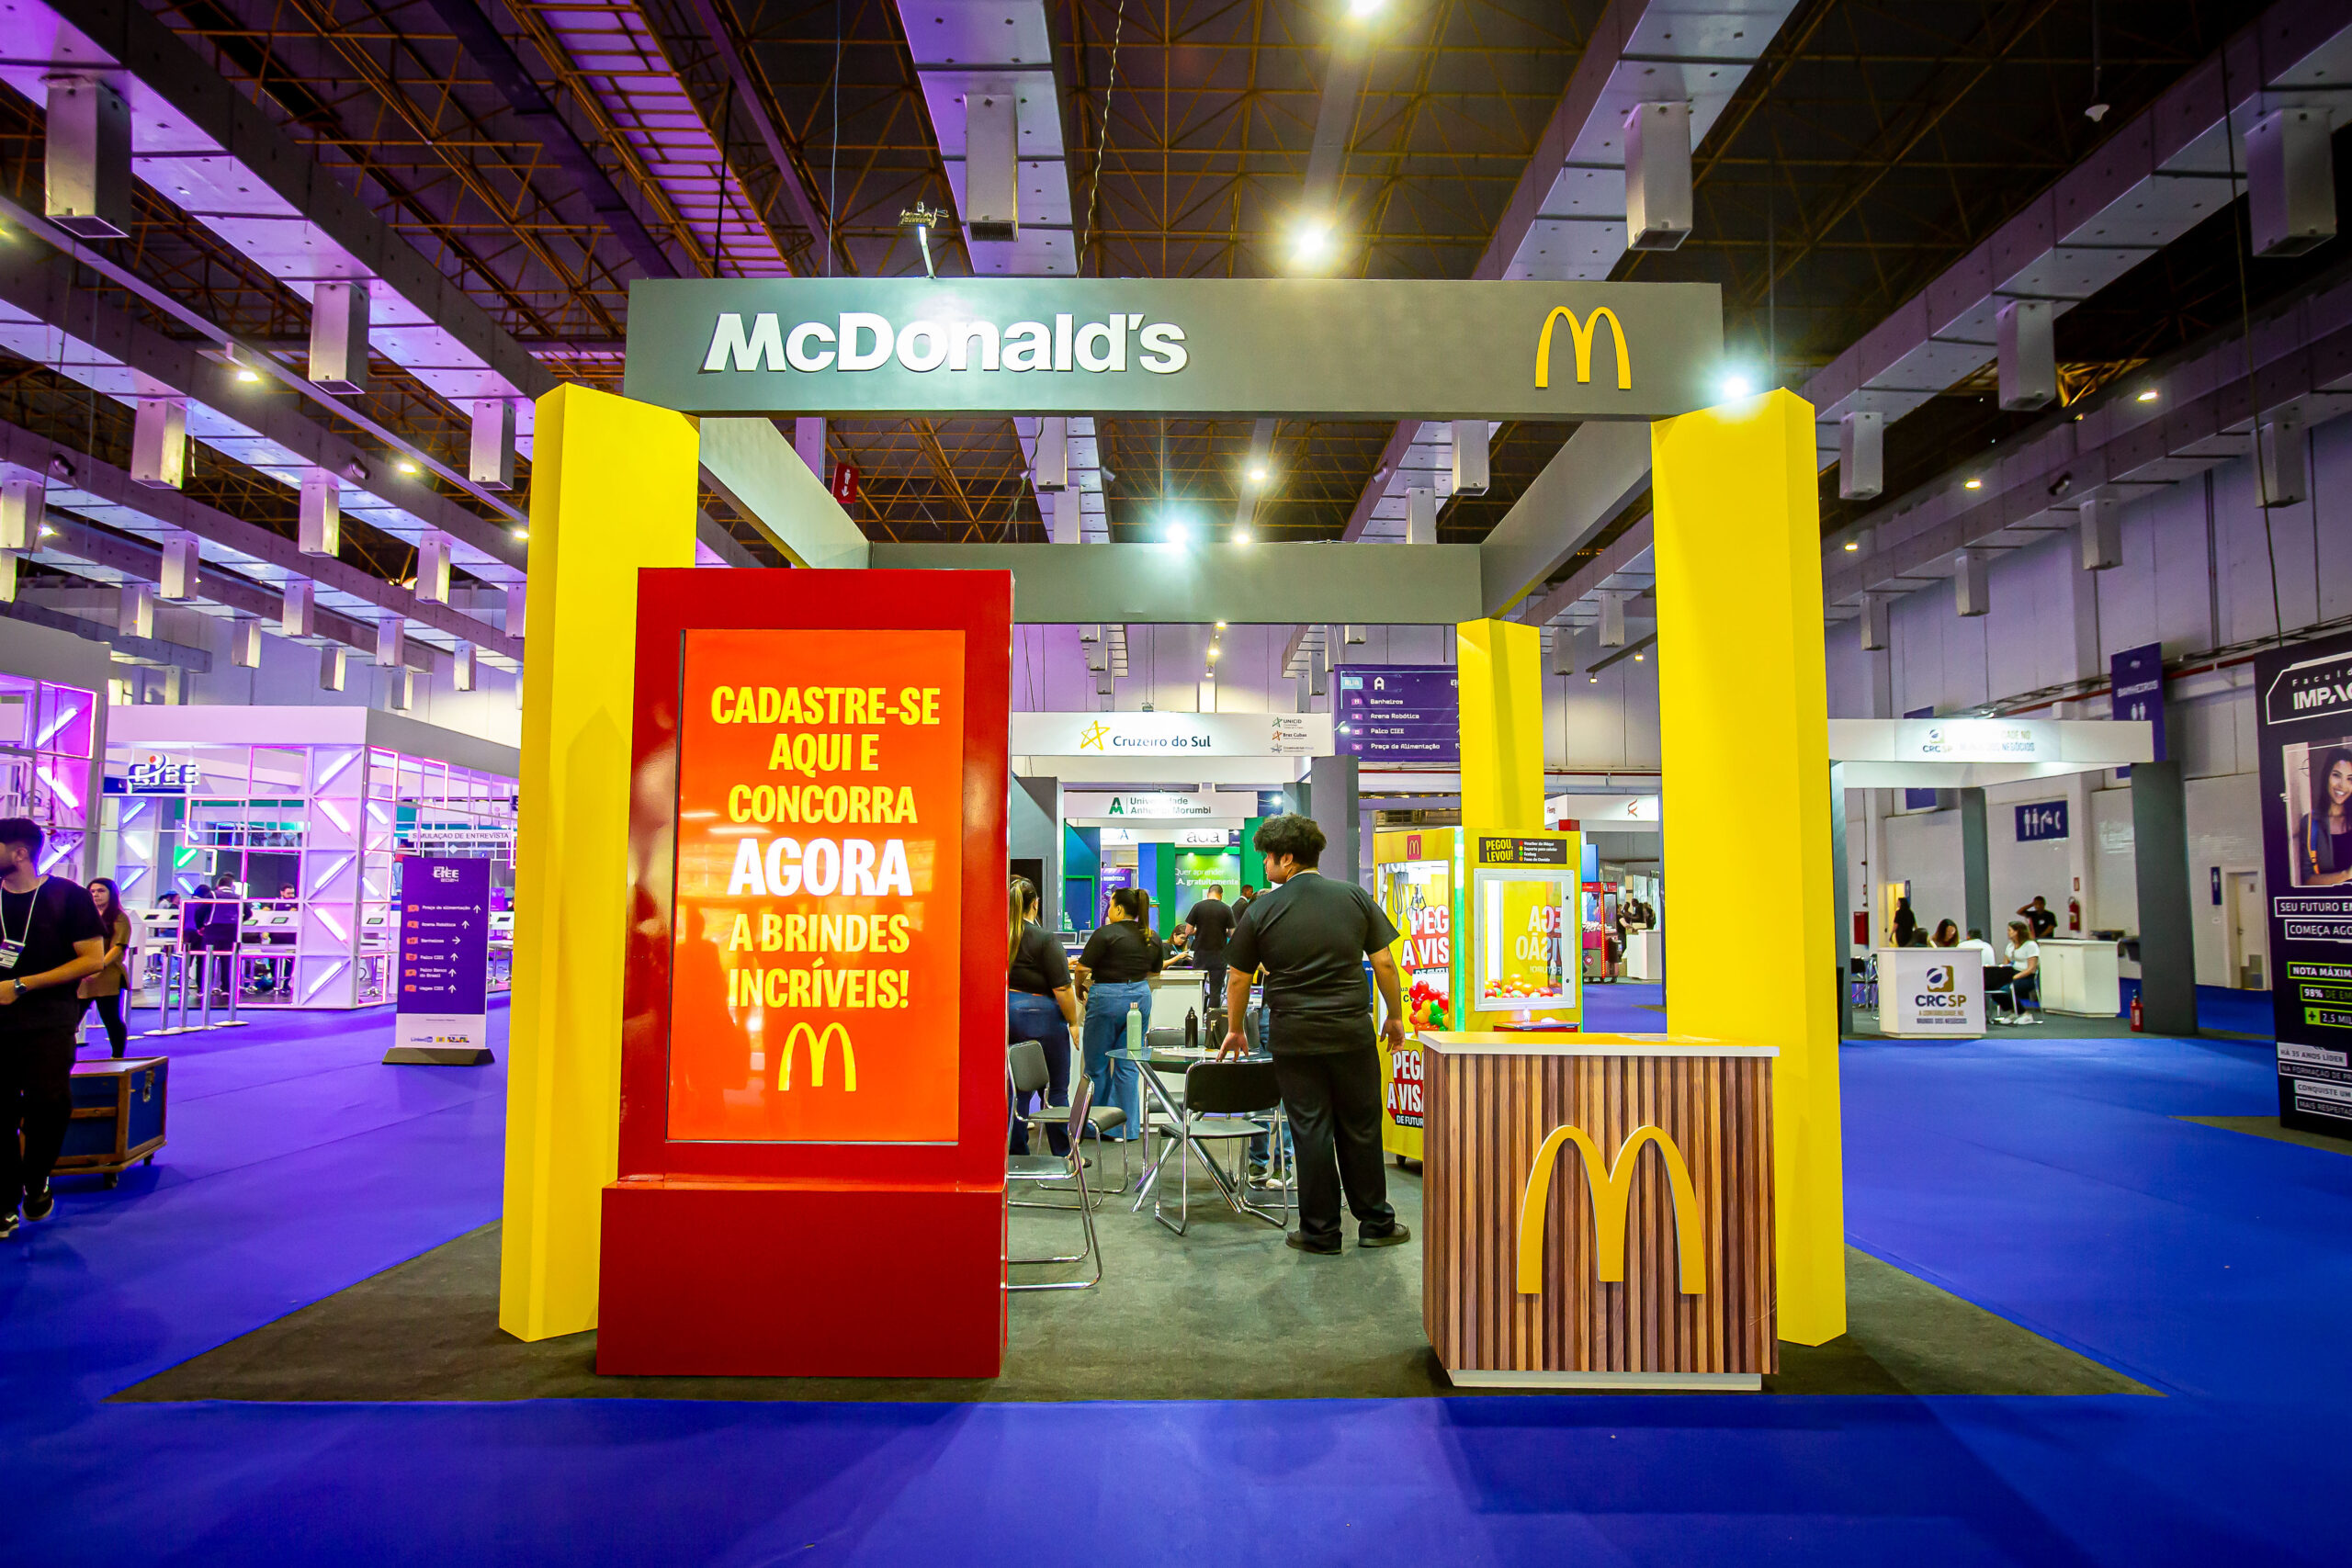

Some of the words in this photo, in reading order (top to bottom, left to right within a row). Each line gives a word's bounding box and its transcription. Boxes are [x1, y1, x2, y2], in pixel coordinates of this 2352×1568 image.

[703, 312, 1188, 374] McDonald's
[1374, 677, 1385, 690] A
[711, 686, 941, 725] CADASTRE-SE
[1113, 736, 1167, 748] Cruzeiro
[1171, 735, 1187, 748] do
[1191, 735, 1212, 748] Sul
[768, 734, 852, 778] AQUI
[861, 734, 879, 771] E
[728, 784, 918, 824] CONCORRA
[1486, 839, 1514, 851] PEGOU,
[1486, 850, 1514, 862] LEVOU!
[728, 837, 913, 897] AGORA
[2279, 902, 2298, 912] SEU
[2300, 902, 2339, 912] FUTURO
[1410, 904, 1449, 935] PEG
[728, 913, 754, 952] A
[761, 913, 910, 953] BRINDES
[2289, 924, 2330, 936] COMEÇA
[2333, 925, 2352, 936] AGO
[1401, 939, 1417, 966] A
[1418, 936, 1449, 964] VIS
[2292, 966, 2318, 976] NOTA
[2319, 965, 2352, 977] MÁXIM
[728, 957, 910, 1009] INCRÍVEIS!
[2303, 988, 2324, 998] 98%
[2323, 1013, 2336, 1024] 2,5
[2301, 1052, 2321, 1060] ANOS
[2323, 1054, 2344, 1063] LÍDER
[2297, 1084, 2338, 1096] CONQUISTE
[1386, 1082, 1397, 1110] A
[1397, 1083, 1424, 1112] VIS
[1396, 1114, 1404, 1124] DE
[1405, 1115, 1423, 1127] FUTUR
